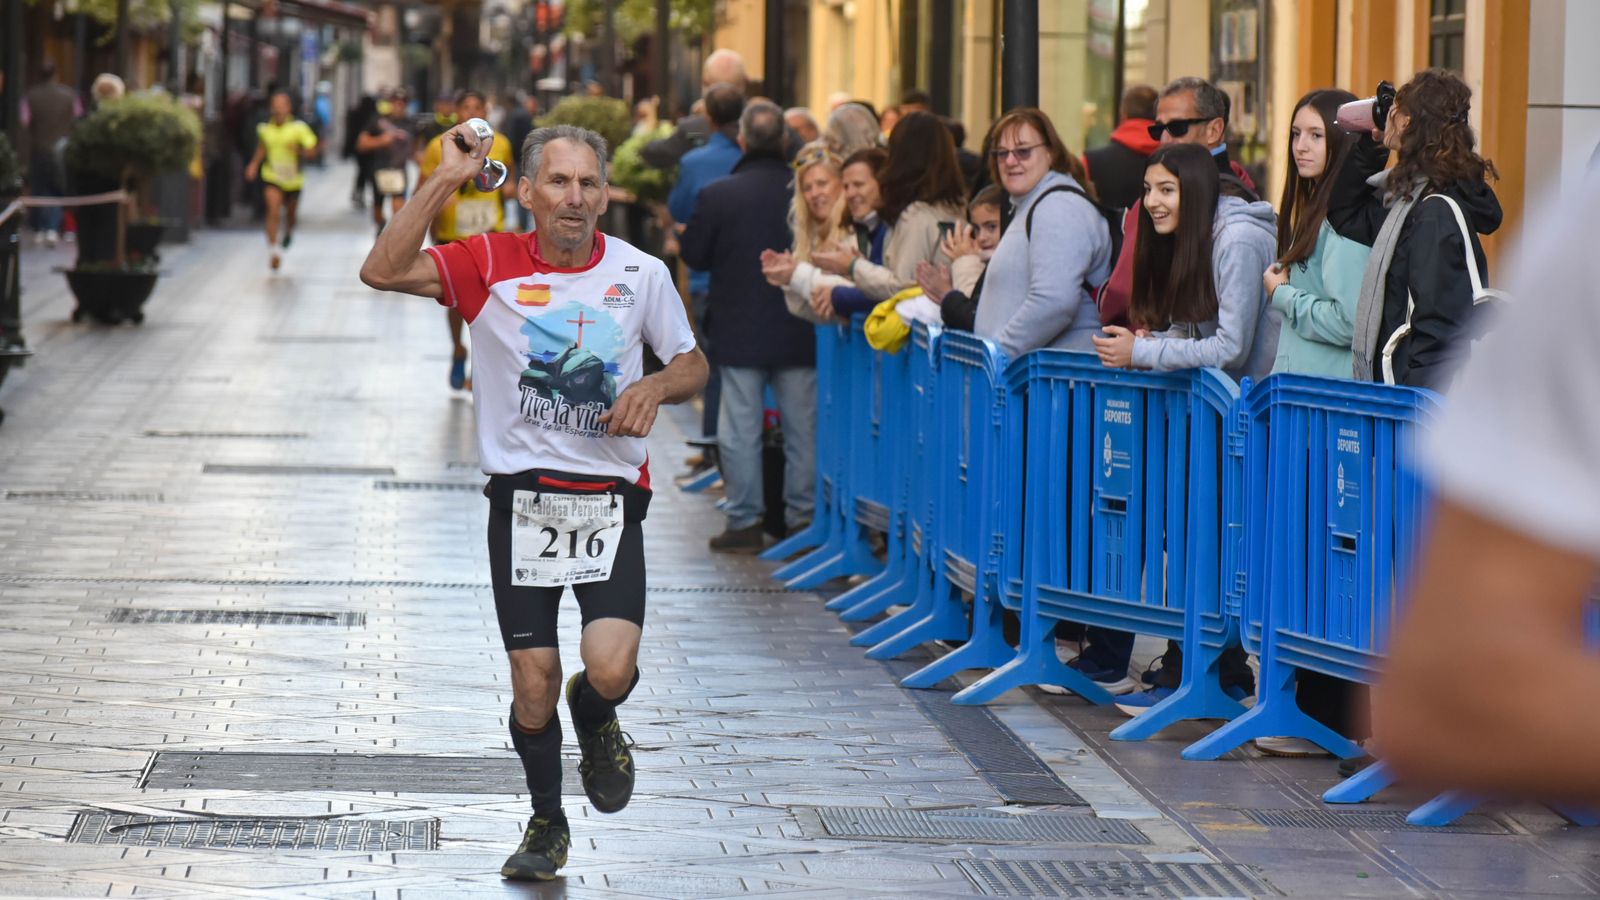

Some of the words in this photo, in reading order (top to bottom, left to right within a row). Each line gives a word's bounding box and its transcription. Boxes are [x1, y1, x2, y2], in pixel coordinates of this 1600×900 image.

[520, 385, 551, 421] Vive
[552, 394, 570, 426] la
[524, 416, 541, 427] Cruz
[543, 419, 552, 430] de
[554, 422, 562, 432] la
[1104, 409, 1132, 424] DEPORTES
[1337, 438, 1360, 454] DEPORTES
[539, 526, 608, 559] 216
